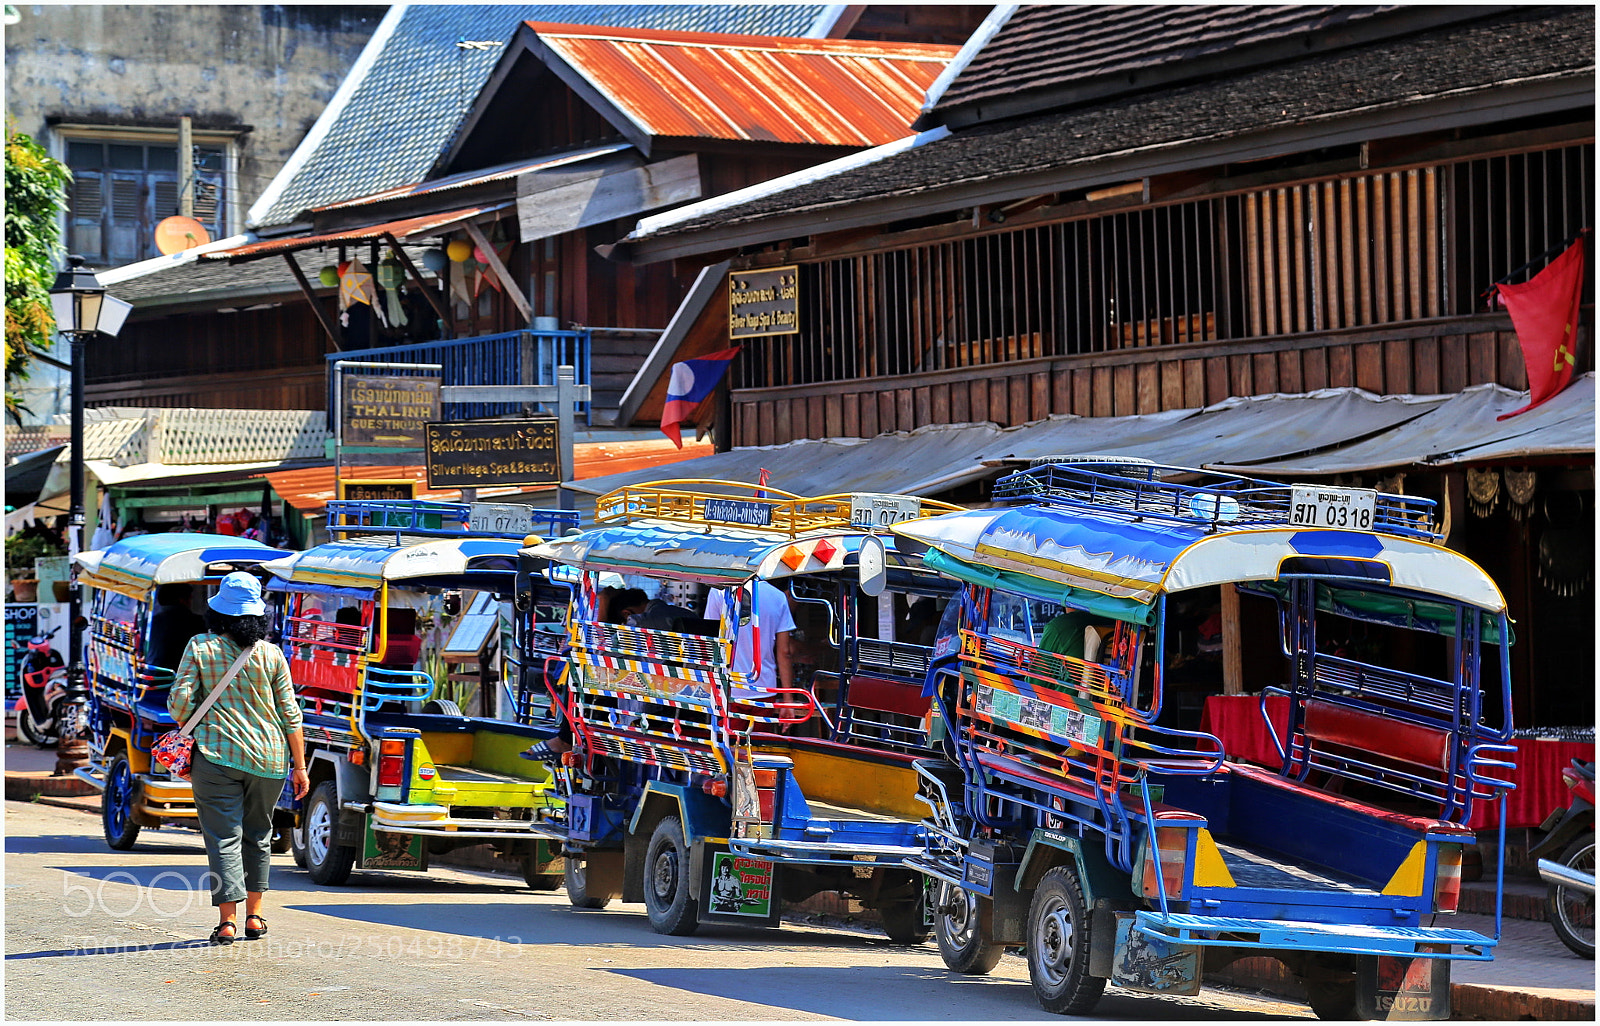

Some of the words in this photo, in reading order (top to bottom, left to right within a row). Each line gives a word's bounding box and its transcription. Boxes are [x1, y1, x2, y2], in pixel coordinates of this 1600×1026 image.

[731, 314, 745, 329] Silver
[746, 313, 759, 331] Naga
[760, 312, 770, 331] Spa
[771, 310, 776, 325] &
[777, 310, 796, 328] Beauty
[353, 405, 431, 418] THALINH
[351, 419, 424, 430] GUESTHOUS
[432, 463, 461, 476] Silver
[462, 461, 489, 478] Naga
[1326, 506, 1370, 528] 0318
[5, 608, 37, 620] SHOP
[1044, 831, 1066, 842] DUNLOP
[1375, 996, 1433, 1012] ISUZU
